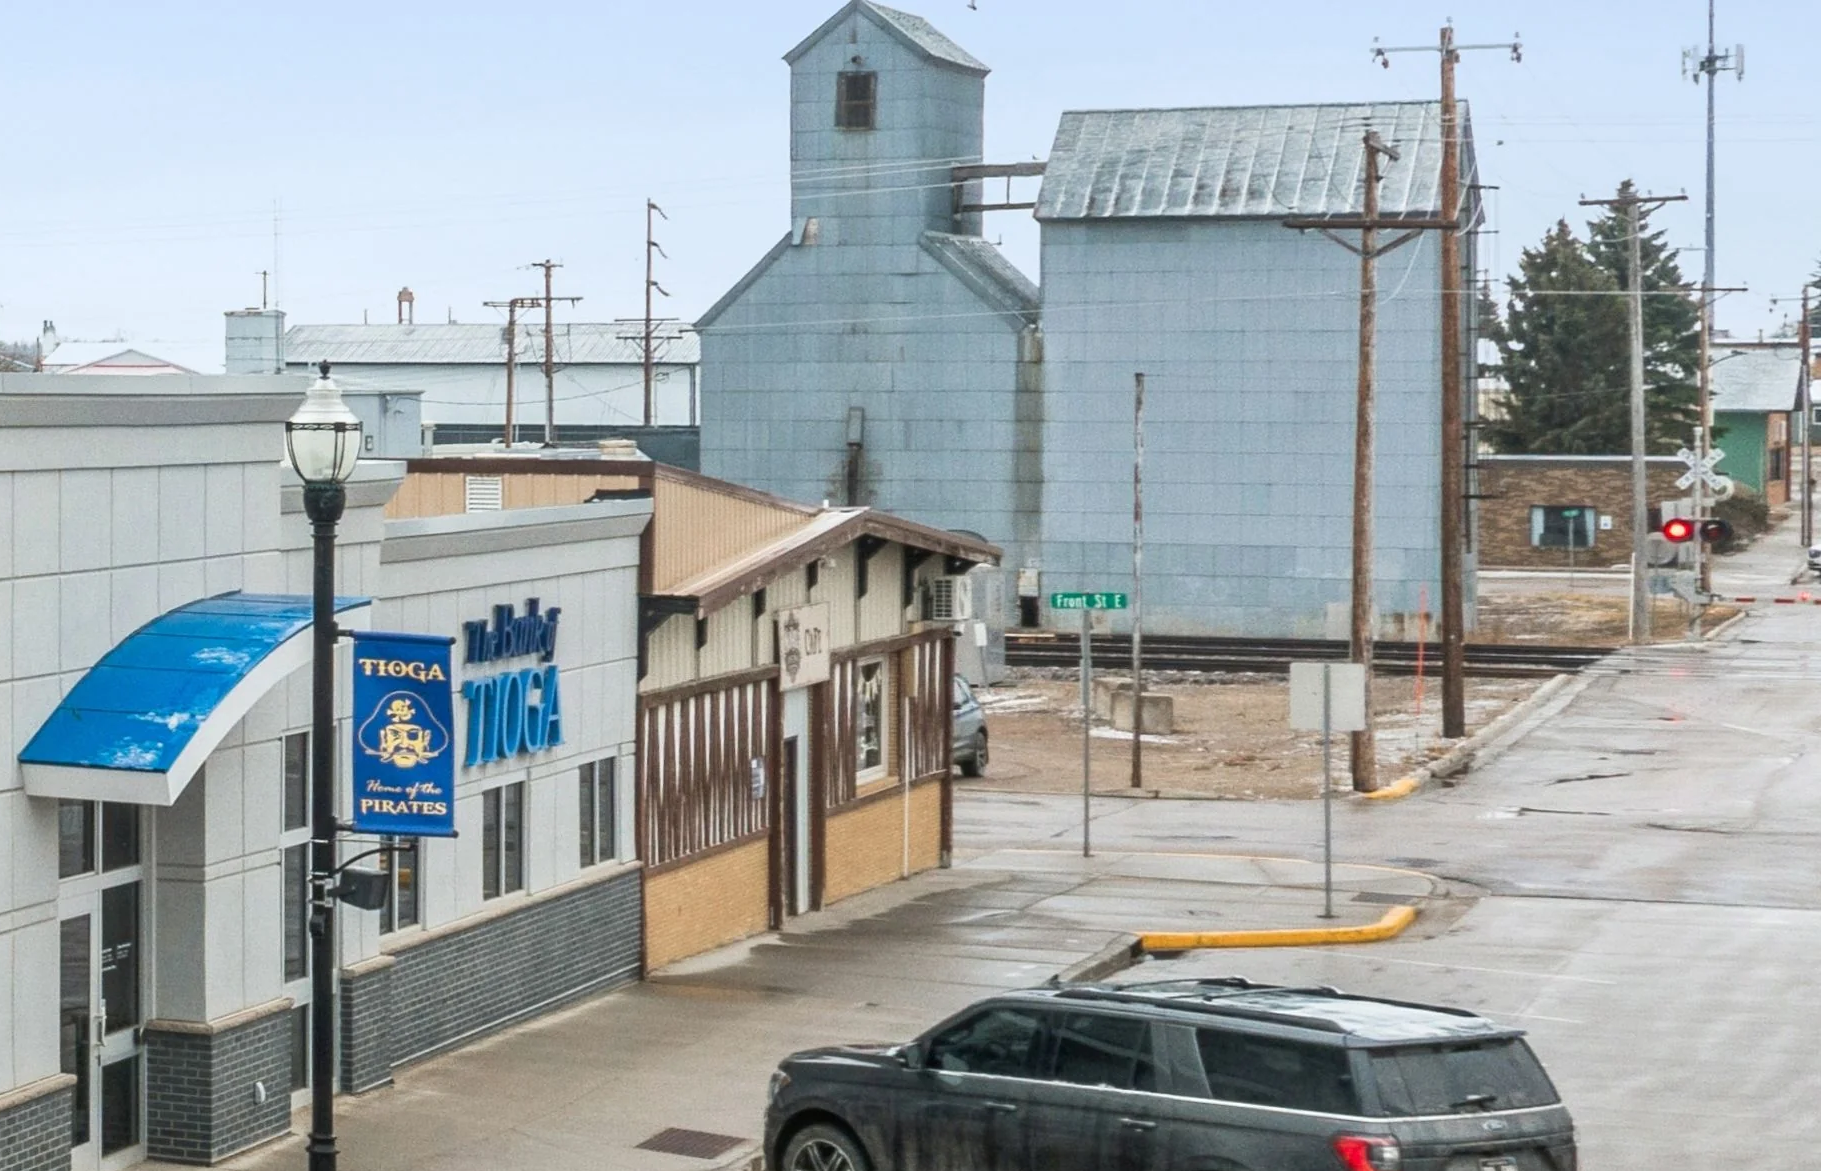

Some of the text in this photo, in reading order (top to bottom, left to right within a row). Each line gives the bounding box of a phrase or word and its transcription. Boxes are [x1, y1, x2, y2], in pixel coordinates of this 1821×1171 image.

[1056, 594, 1122, 608] Front St E
[492, 598, 544, 659] Bank
[358, 658, 447, 683] TIOGA
[462, 665, 565, 767] TIOGA
[366, 779, 443, 799] Home of the
[360, 799, 448, 815] PIRATES
